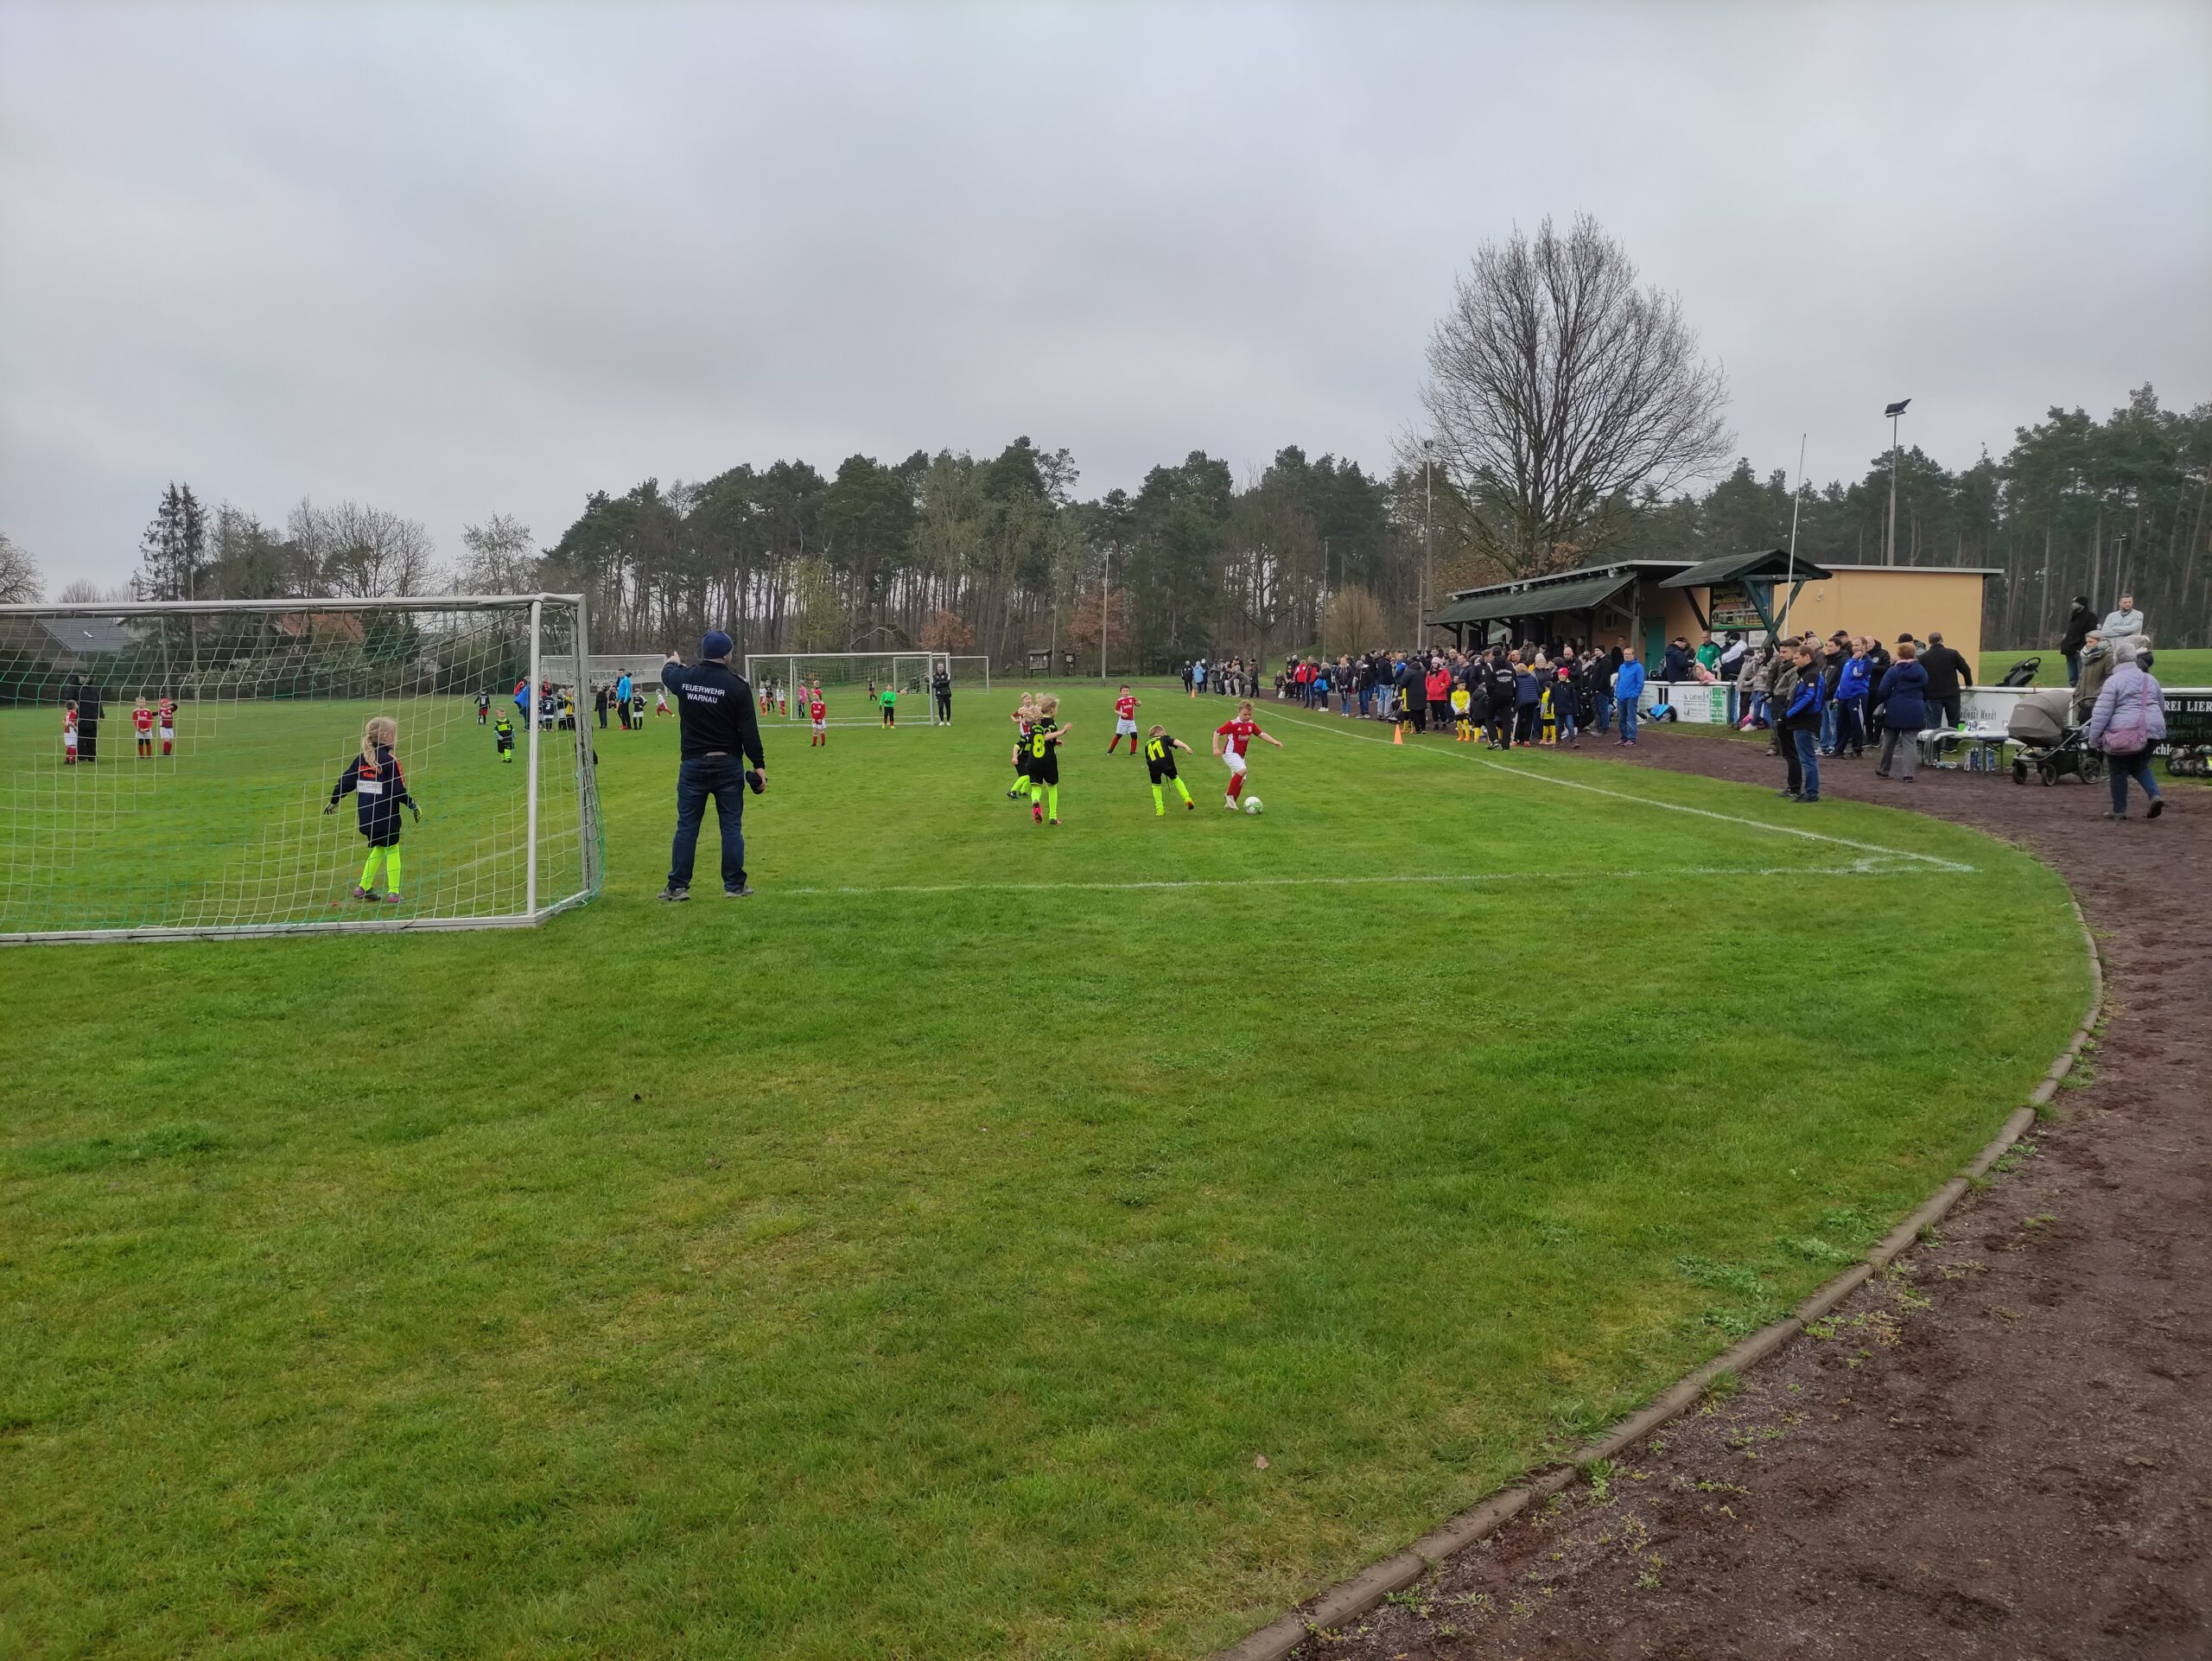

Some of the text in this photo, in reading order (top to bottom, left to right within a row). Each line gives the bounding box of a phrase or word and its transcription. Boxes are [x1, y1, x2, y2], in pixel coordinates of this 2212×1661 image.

[682, 683, 726, 697] FEUERWEHR
[687, 692, 718, 703] WARNAU
[2164, 701, 2182, 711] REI
[1033, 733, 1046, 759] 8
[1147, 739, 1166, 761] 11
